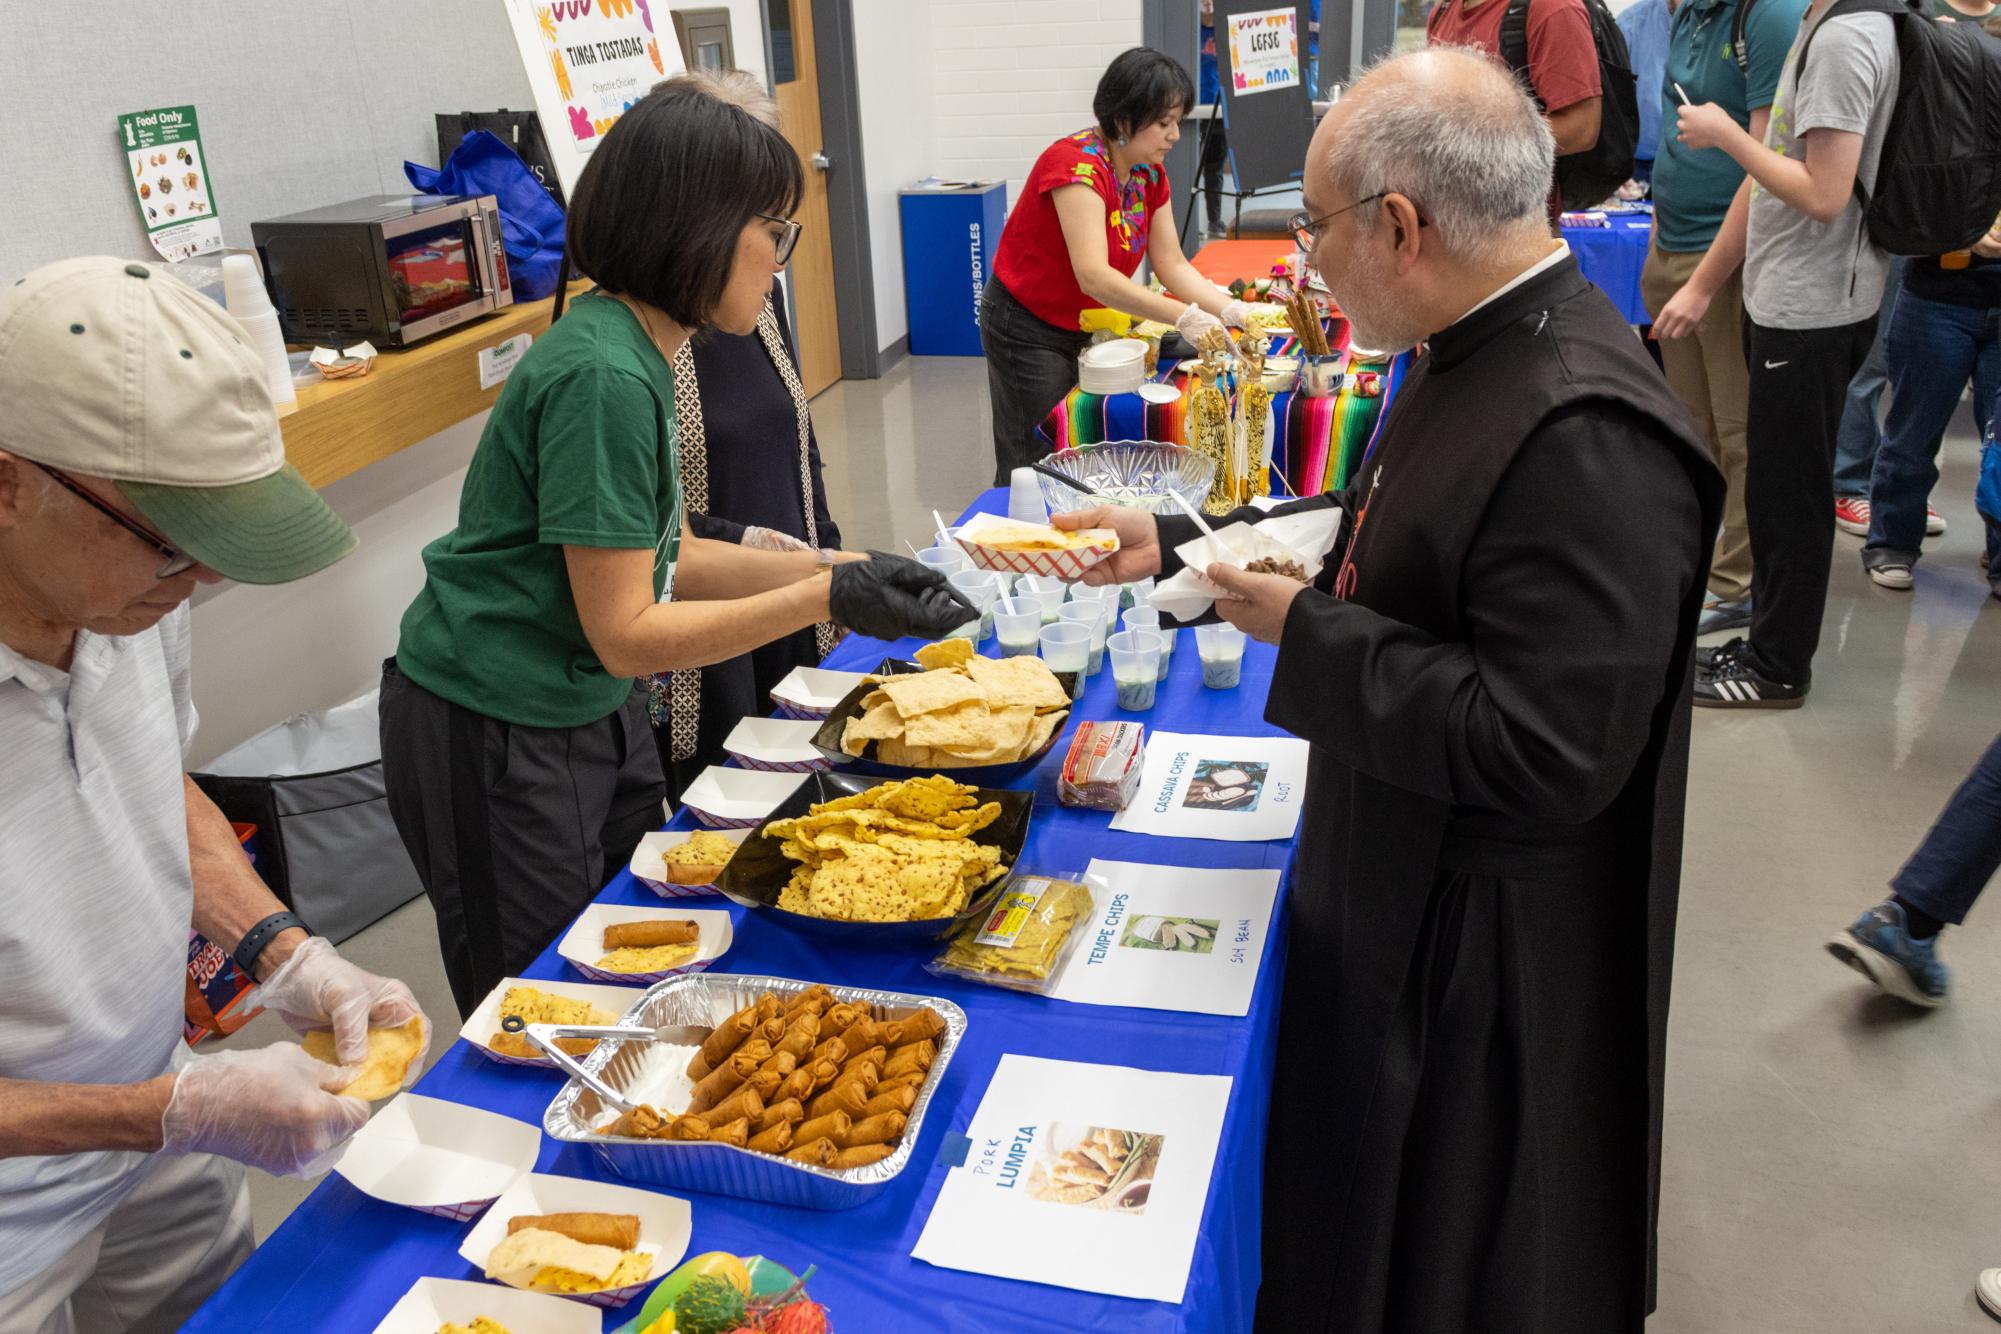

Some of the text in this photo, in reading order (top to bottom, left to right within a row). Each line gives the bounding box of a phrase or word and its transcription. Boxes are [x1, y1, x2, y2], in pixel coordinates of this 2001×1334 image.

[566, 36, 644, 67] TINGA TOSTADAS
[1251, 31, 1280, 52] LEFSE
[615, 77, 638, 89] Chicken
[135, 113, 158, 127] Food
[159, 110, 182, 124] Only
[969, 222, 983, 316] CANS/BOTTLES
[1154, 751, 1189, 813] CASSAVA CHIPS
[1274, 781, 1292, 803] ROOT
[1087, 893, 1129, 965] TEMPE CHIPS
[1230, 919, 1252, 964] SOY BEAN
[973, 1139, 1002, 1175] PORK
[996, 1126, 1037, 1188] LUMPIA
